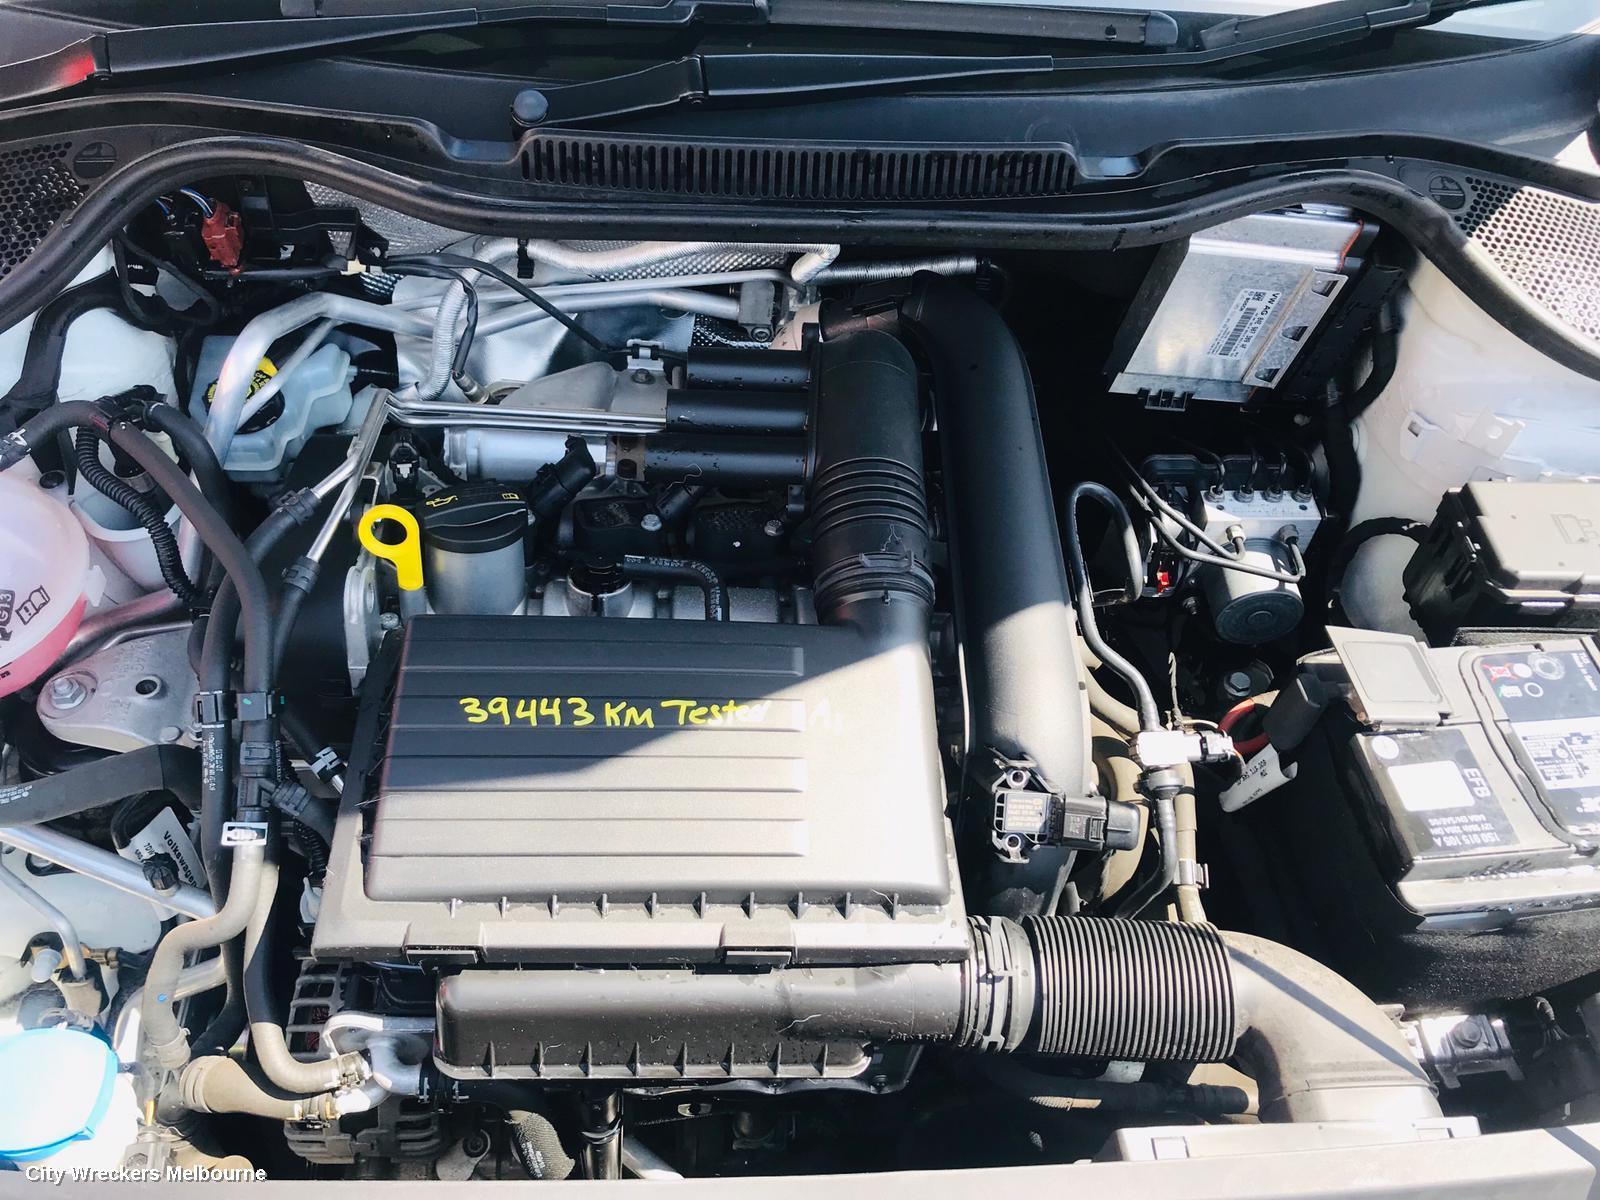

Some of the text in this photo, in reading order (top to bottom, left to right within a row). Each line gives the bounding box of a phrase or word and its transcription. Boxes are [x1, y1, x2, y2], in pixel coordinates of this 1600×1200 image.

[1268, 292, 1280, 305] VW
[1260, 305, 1271, 316] AG
[459, 697, 595, 726] 39443
[1463, 767, 1492, 798] EFB
[1432, 836, 1442, 848] A
[163, 830, 198, 889] Volkswagen
